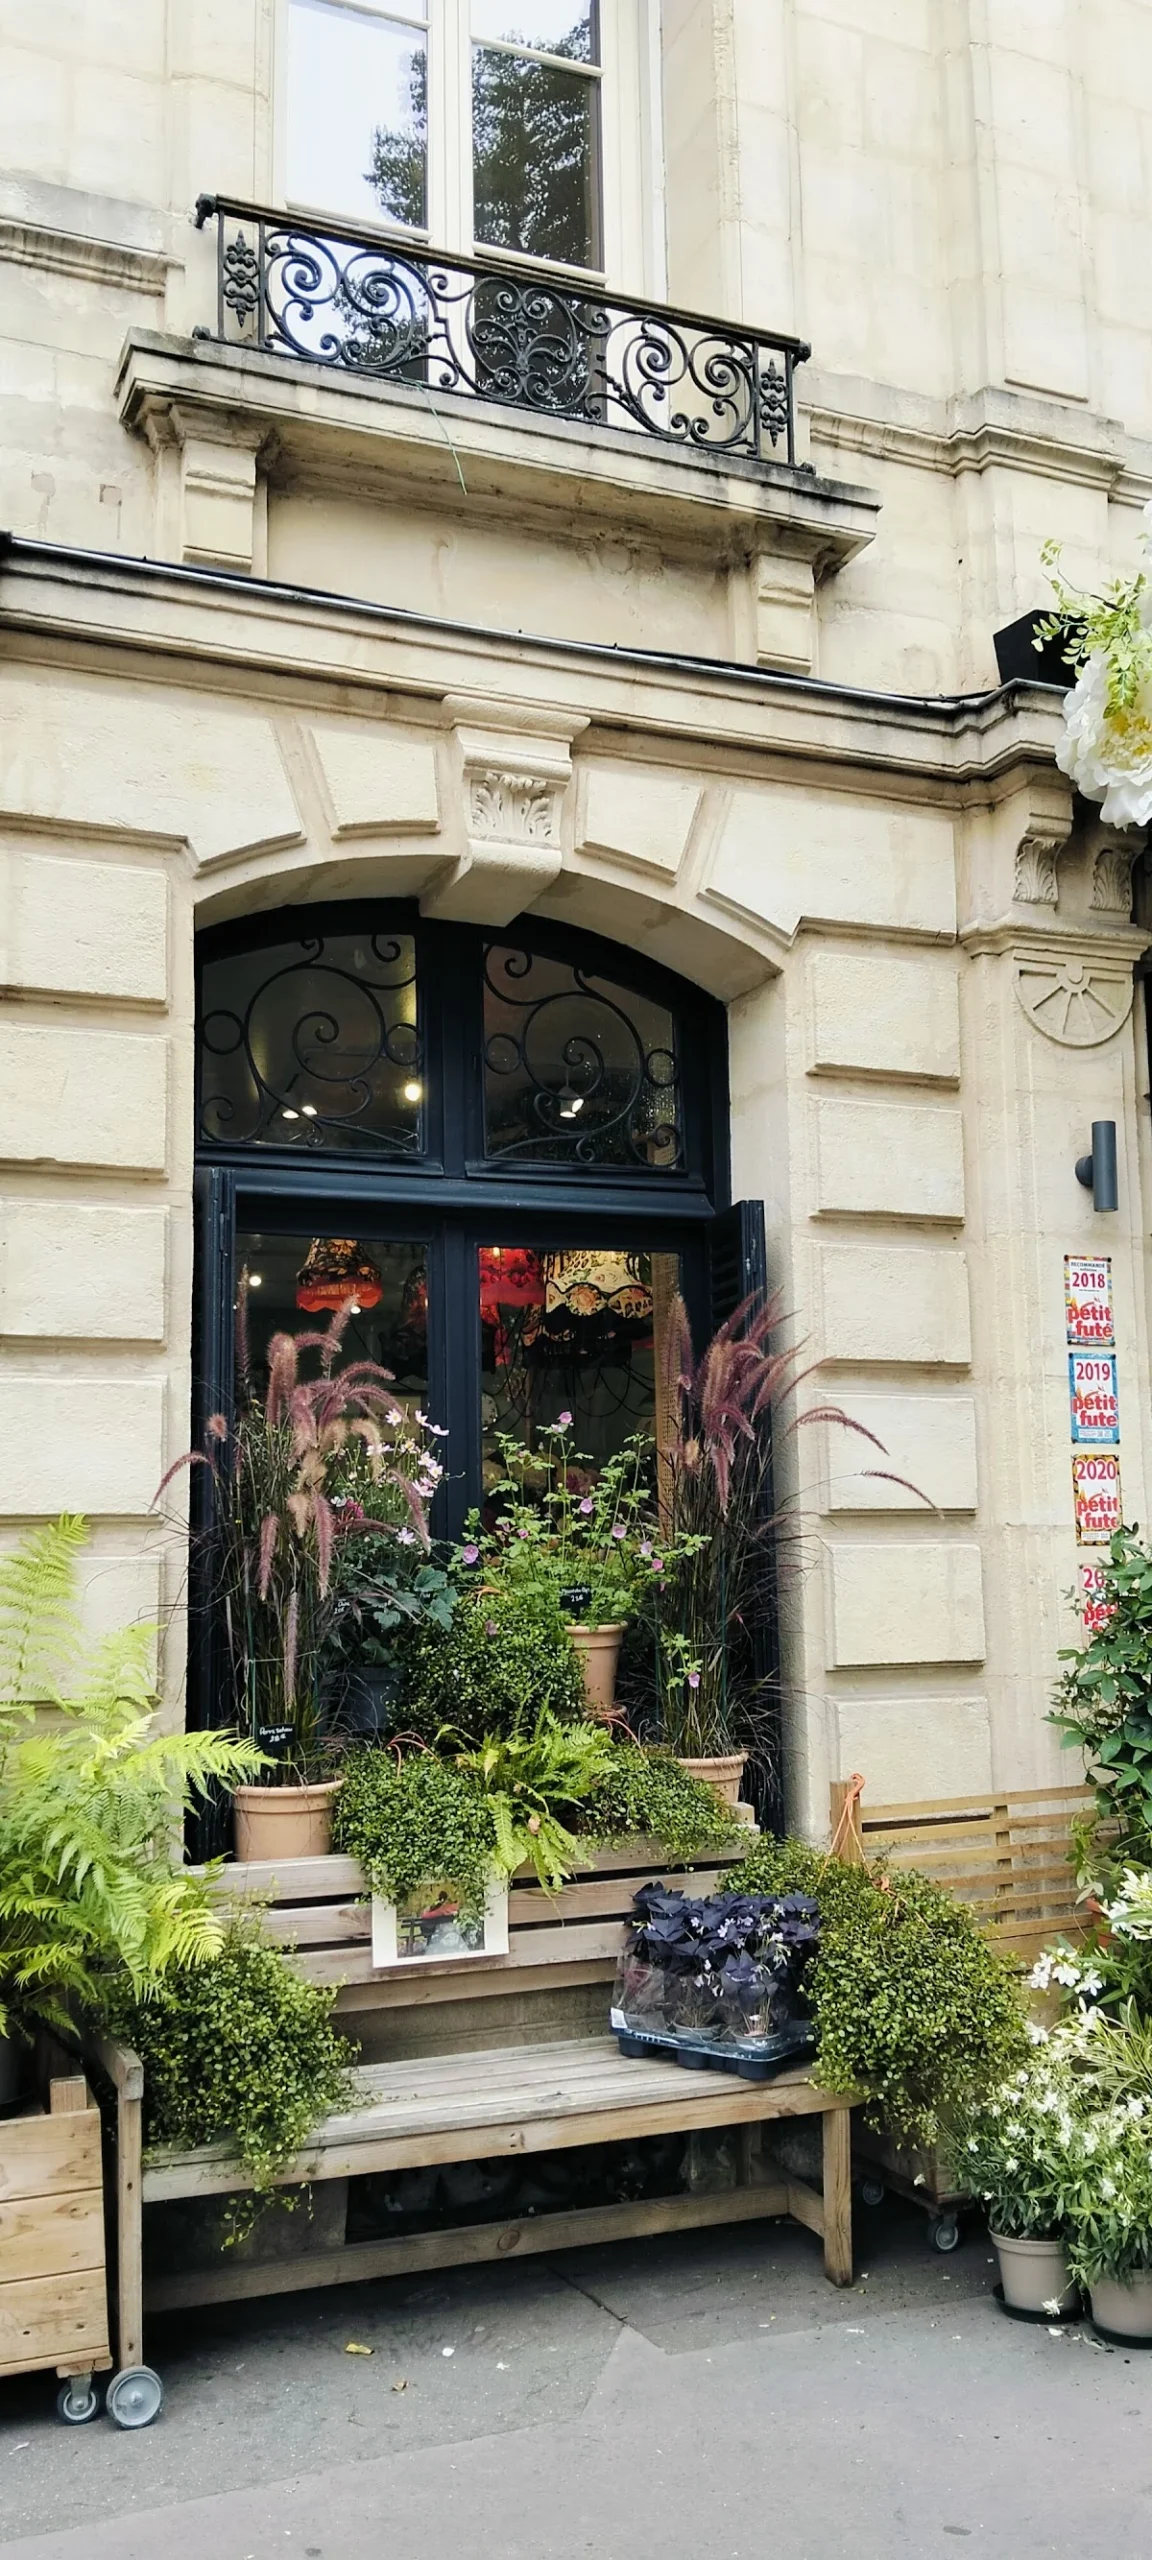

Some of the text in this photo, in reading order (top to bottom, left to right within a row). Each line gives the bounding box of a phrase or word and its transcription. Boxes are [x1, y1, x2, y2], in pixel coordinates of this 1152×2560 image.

[1072, 1272, 1105, 1288] 2018
[1067, 1305, 1112, 1324] petit
[1076, 1362, 1111, 1381] 2019
[1072, 1394, 1116, 1413] petit
[1076, 1460, 1117, 1480] 2020
